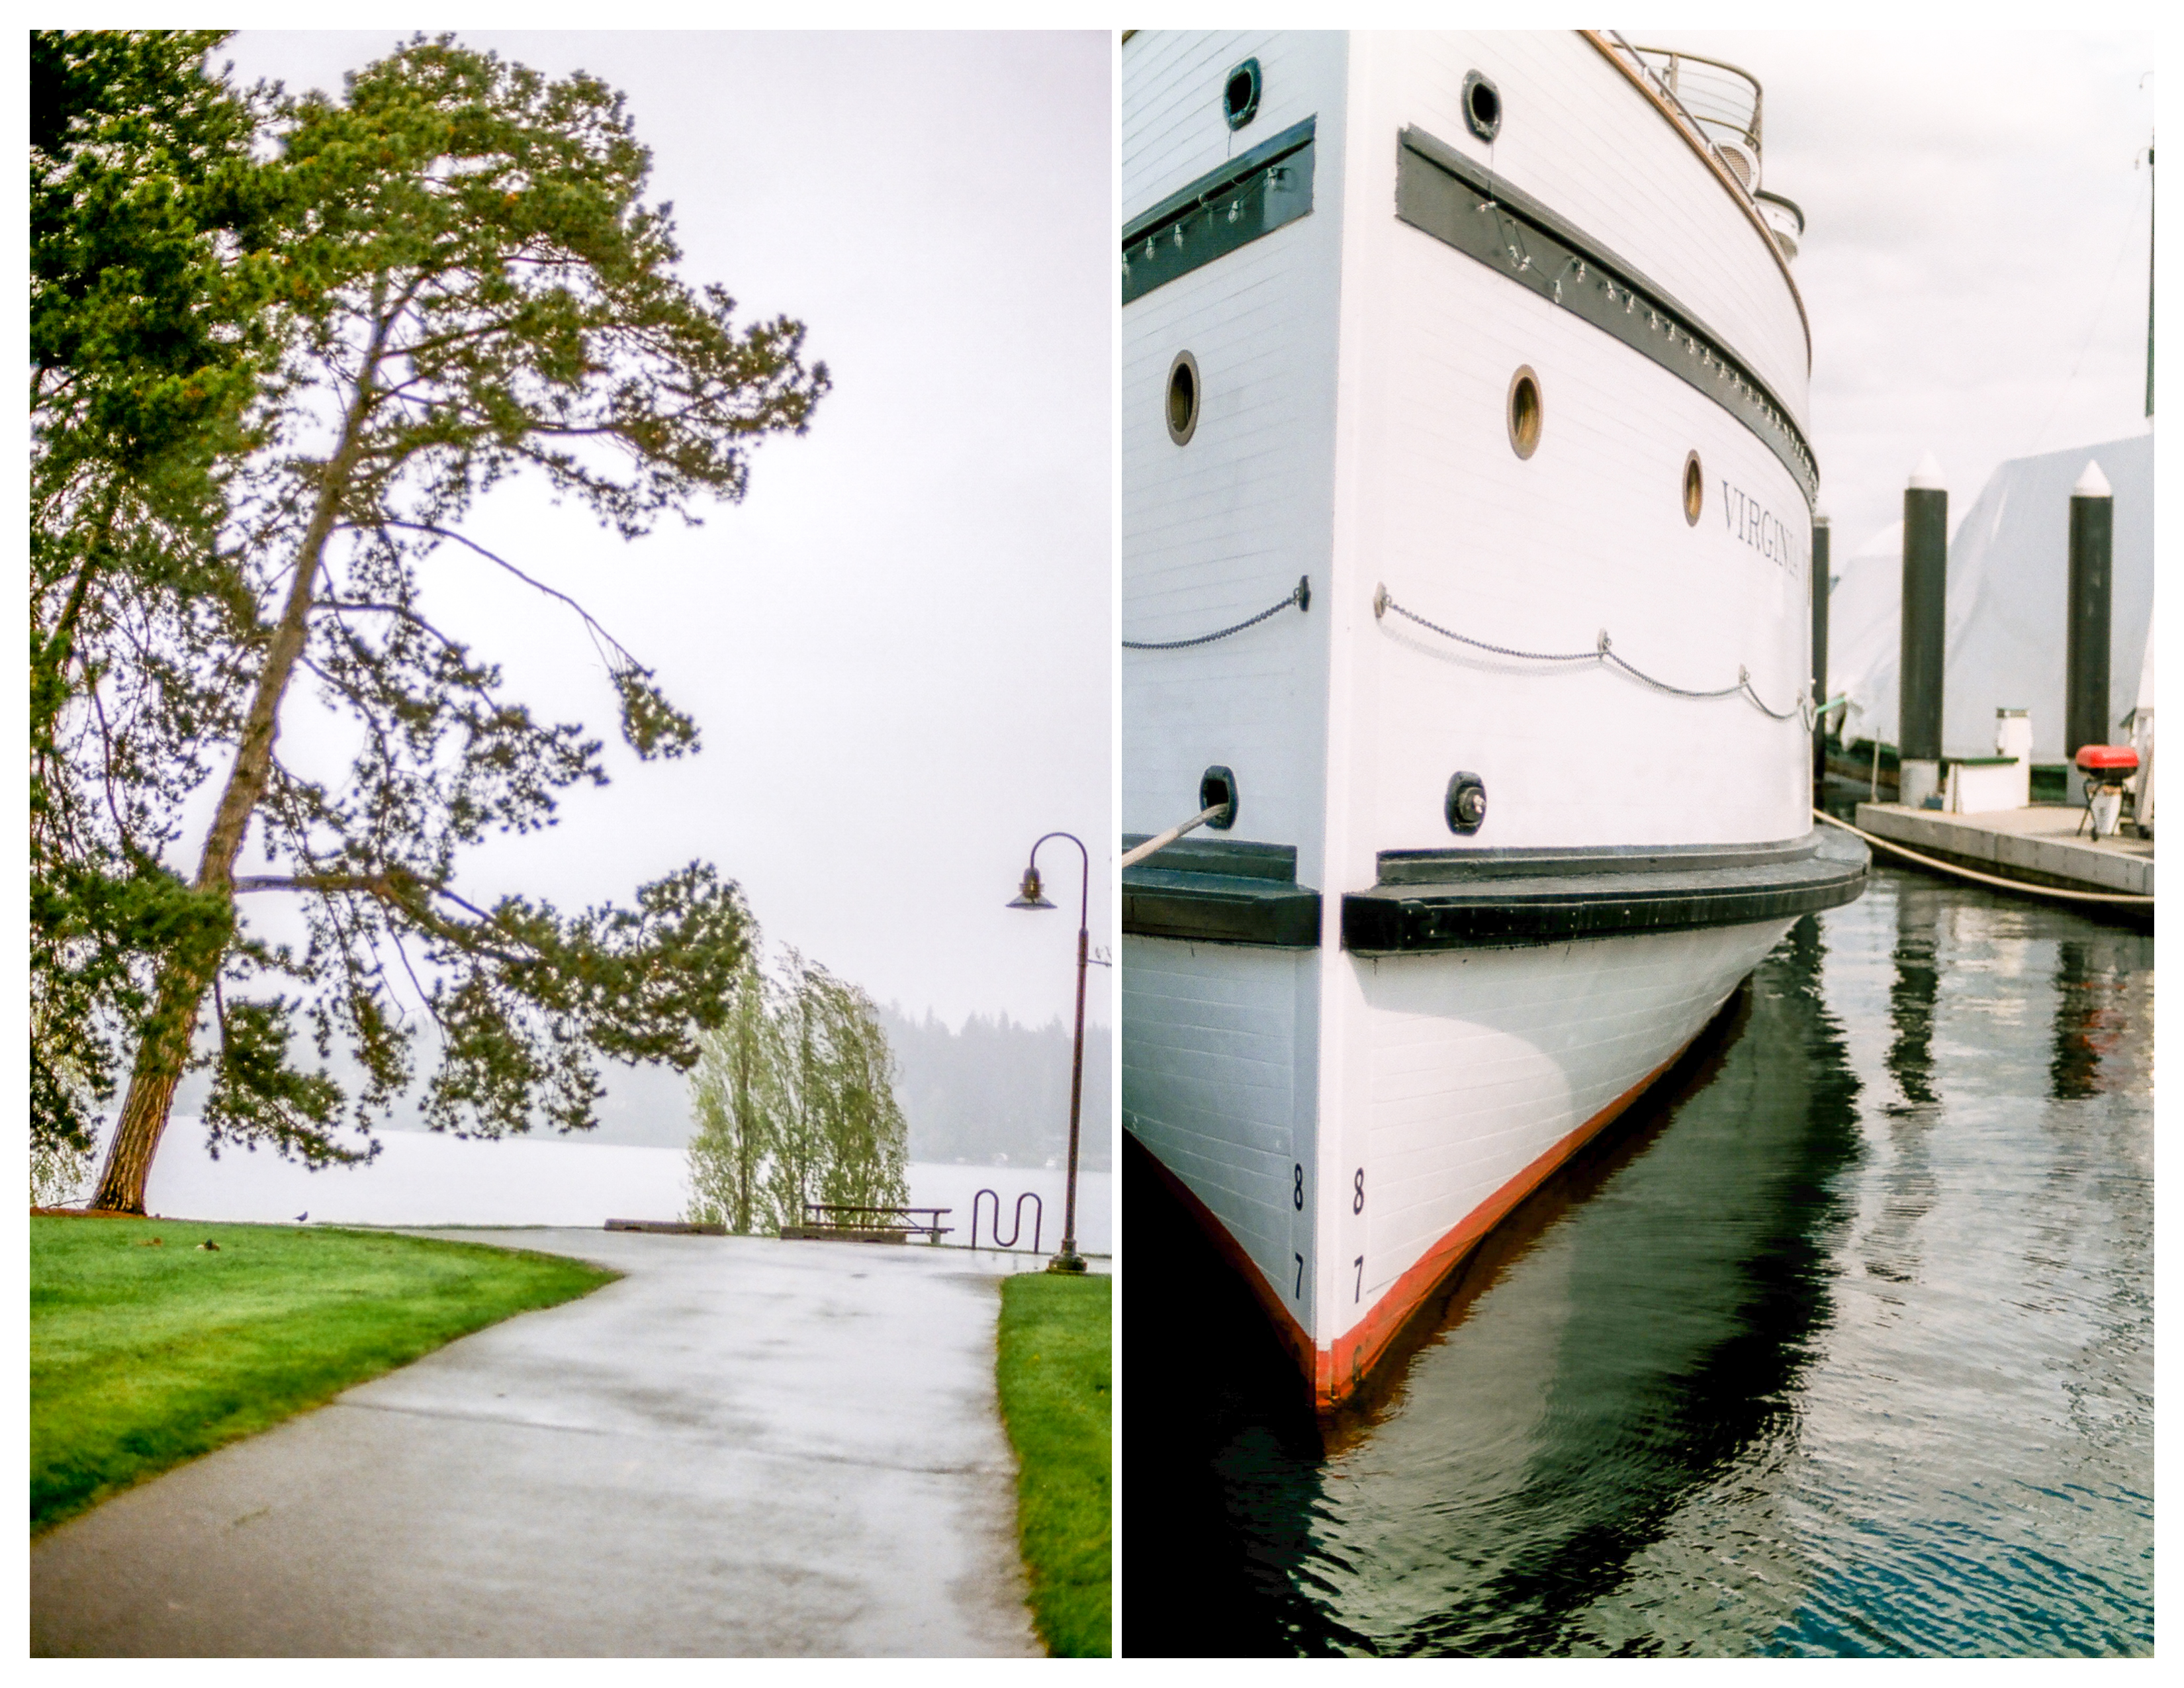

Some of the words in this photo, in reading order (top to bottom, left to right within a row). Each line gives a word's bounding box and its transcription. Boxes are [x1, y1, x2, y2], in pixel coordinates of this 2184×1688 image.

[1294, 1163, 1303, 1211] 8
[1353, 1168, 1364, 1215] 8
[1295, 1252, 1304, 1300] 7
[1354, 1255, 1363, 1304] 7
